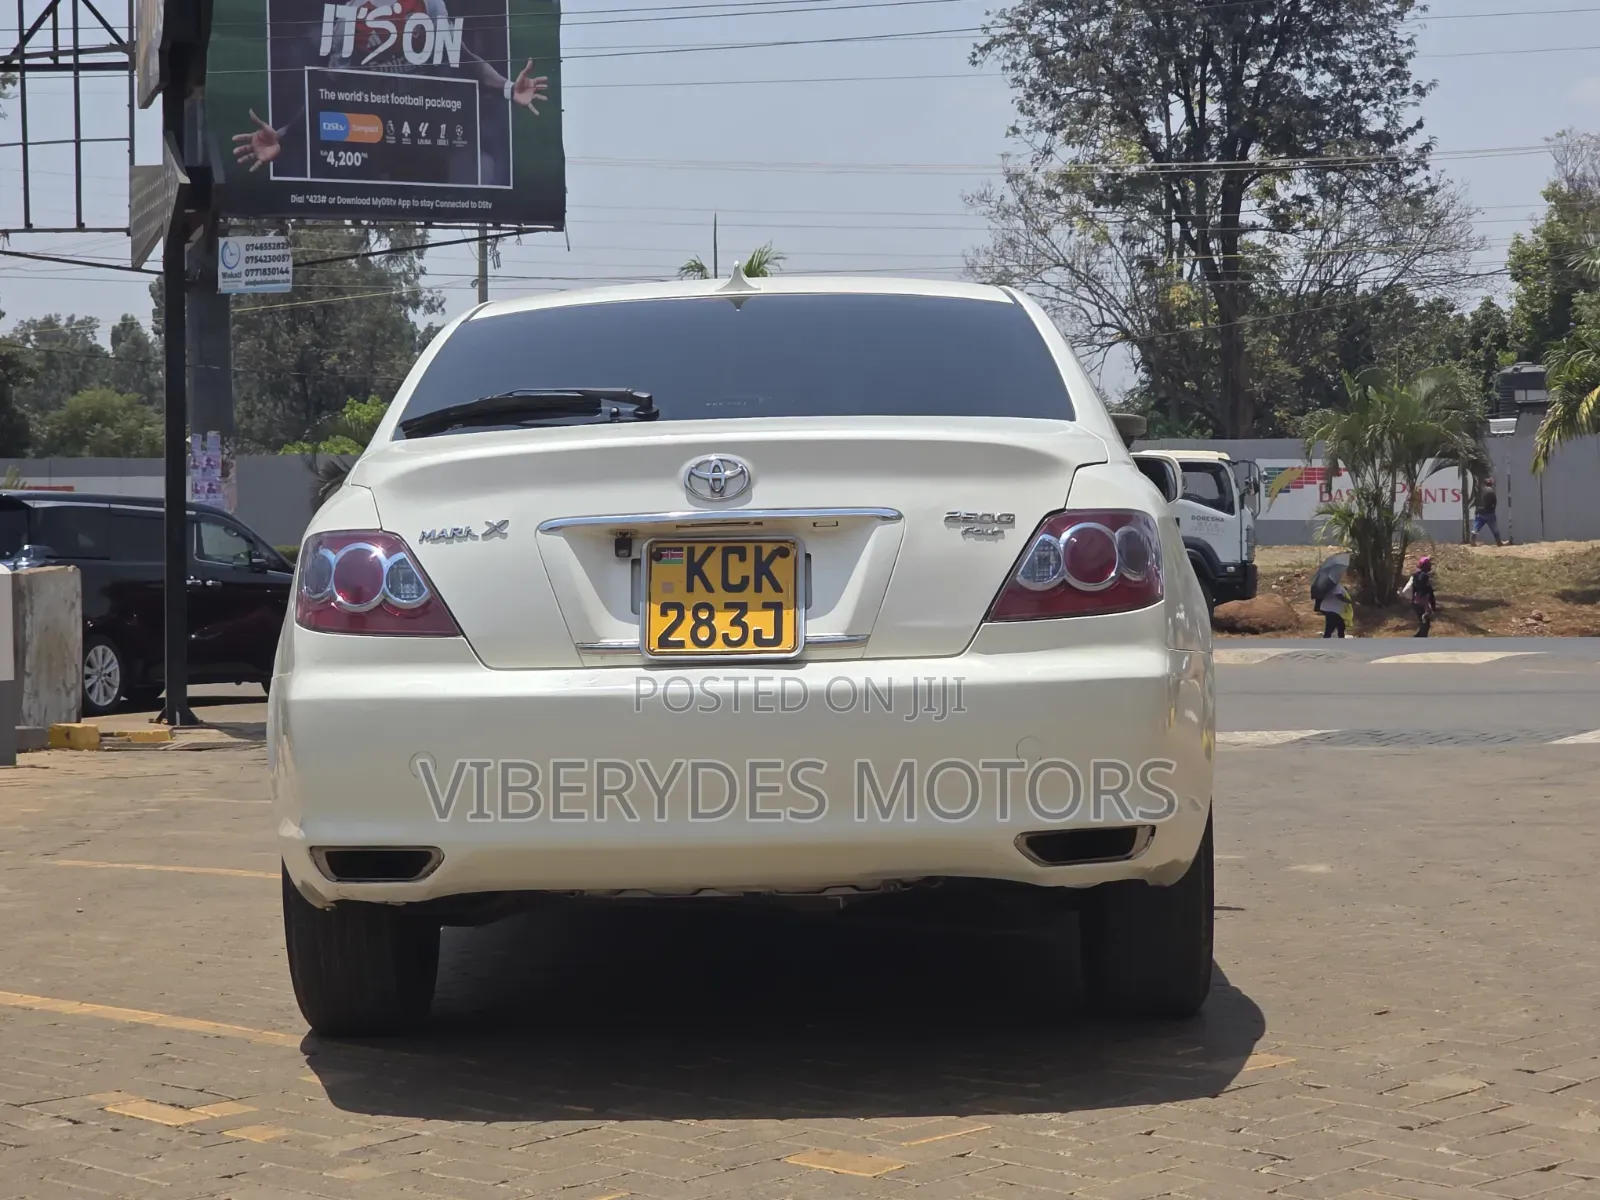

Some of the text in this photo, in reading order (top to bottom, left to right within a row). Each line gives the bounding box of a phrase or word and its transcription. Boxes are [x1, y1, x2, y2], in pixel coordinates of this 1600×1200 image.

[319, 3, 464, 68] IT'S ON
[319, 88, 462, 112] The world's best football package
[326, 151, 362, 167] 4,200
[291, 194, 304, 203] Dial
[337, 196, 371, 205] Download
[372, 197, 396, 208] MyDStv
[397, 198, 411, 209] App
[412, 199, 419, 207] to
[420, 199, 434, 209] stay
[435, 200, 469, 208] Connected
[470, 200, 477, 208] to
[478, 201, 492, 209] DStv
[244, 267, 290, 277] 0771830144
[419, 519, 510, 543] MARK X
[686, 545, 791, 594] KCK
[657, 601, 784, 649] 283J
